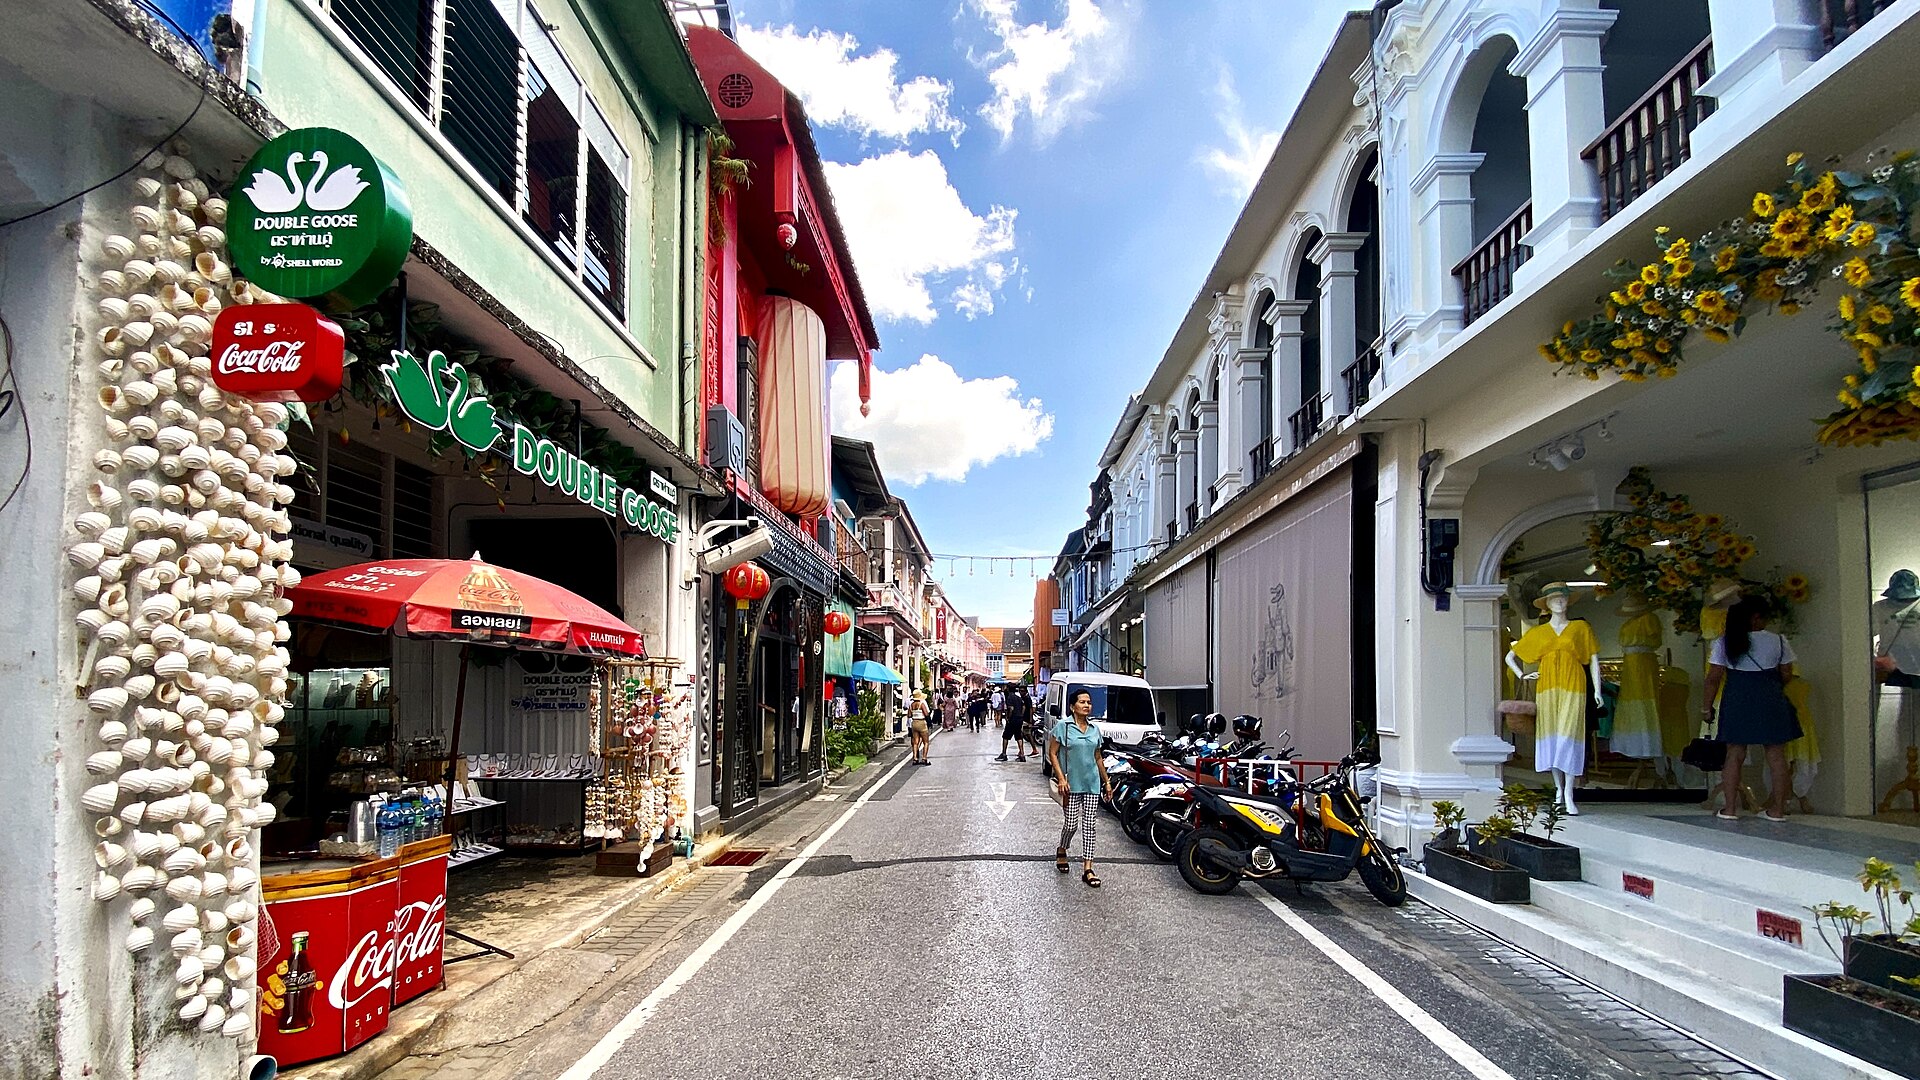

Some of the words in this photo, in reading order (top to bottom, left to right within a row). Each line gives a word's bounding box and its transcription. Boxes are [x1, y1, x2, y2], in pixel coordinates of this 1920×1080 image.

[254, 216, 309, 230] DOUBLE
[311, 214, 358, 228] GOOSE
[260, 256, 272, 266] by
[286, 259, 311, 268] SHELL
[312, 258, 343, 267] WORLD
[218, 341, 306, 374] Coca-Cola
[514, 423, 617, 517] DOUBLE
[622, 488, 678, 545] GOOSE
[329, 534, 368, 553] quality
[460, 614, 522, 630] ลองเลย!
[590, 632, 626, 646] HAADTHIP
[523, 675, 560, 685] DOUBLE
[511, 699, 521, 707] by
[534, 702, 557, 710] SHELL
[558, 702, 586, 710] WORLD
[1763, 924, 1794, 943] EXIT
